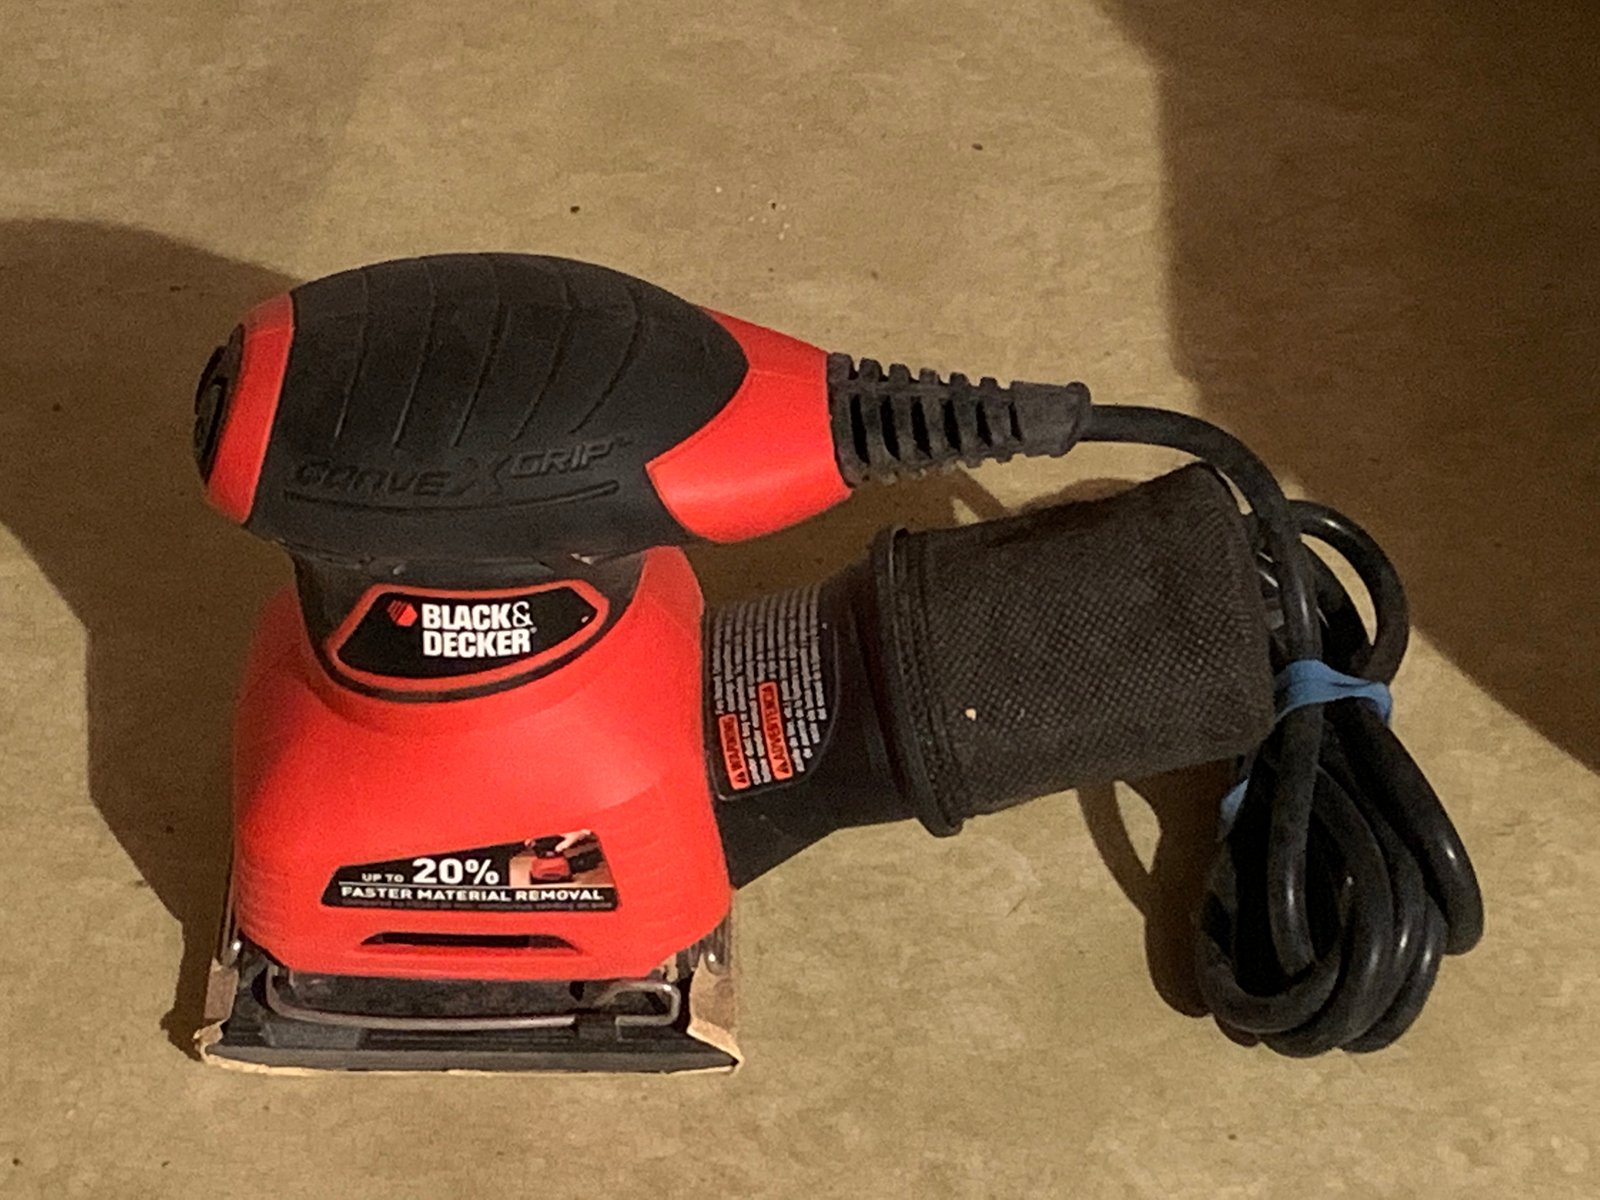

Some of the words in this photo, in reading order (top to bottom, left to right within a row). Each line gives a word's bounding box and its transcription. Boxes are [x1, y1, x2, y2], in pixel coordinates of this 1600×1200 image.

[508, 440, 615, 478] GRIP
[422, 628, 532, 658] DECKER
[361, 873, 382, 883] UP
[385, 873, 405, 883] TO
[412, 857, 500, 885] 20%
[341, 886, 413, 900] FASTER
[416, 889, 511, 902] MATERIAL
